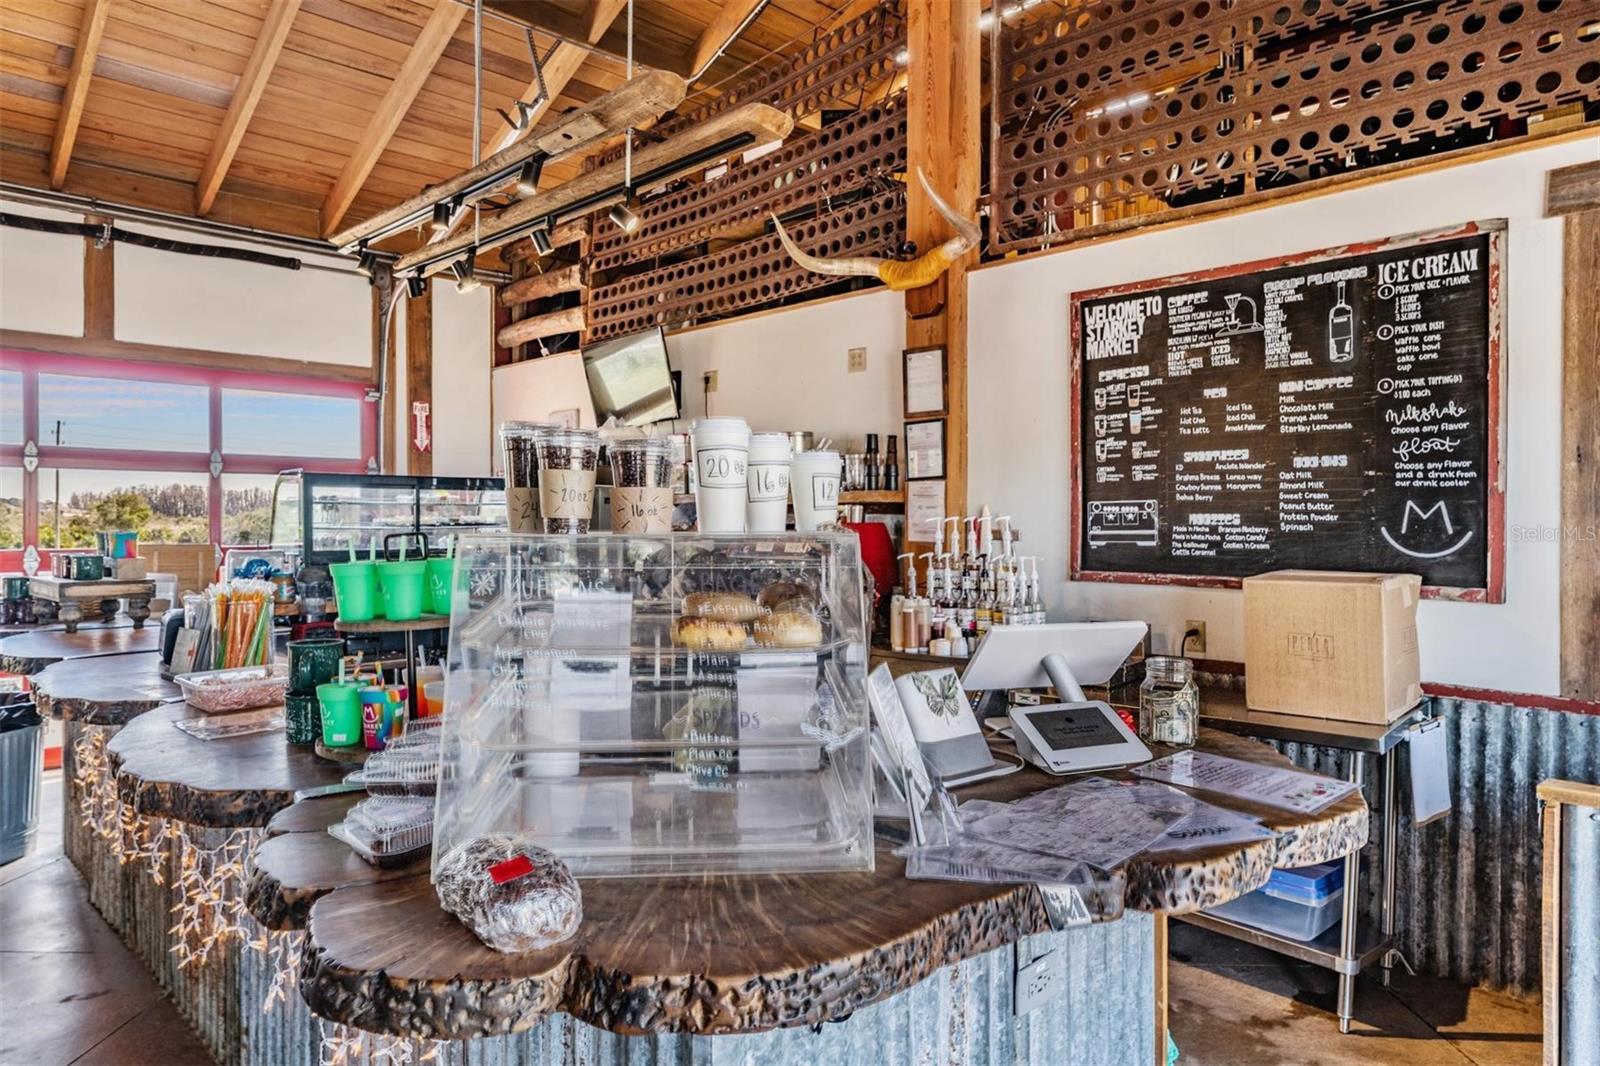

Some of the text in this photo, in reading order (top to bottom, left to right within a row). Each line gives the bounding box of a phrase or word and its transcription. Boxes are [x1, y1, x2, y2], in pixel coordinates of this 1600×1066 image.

[1378, 248, 1479, 285] ICE CREAM
[1395, 284, 1410, 294] PICK
[1411, 281, 1426, 292] YOUR
[1168, 291, 1208, 309] COFFEE
[1400, 302, 1421, 313] SCOOPS
[1400, 311, 1421, 321] SCOOPS
[1086, 316, 1146, 341] STARKEY
[1395, 320, 1445, 335] PICK YOUR DISH
[1395, 334, 1441, 345] waffle cone
[1086, 334, 1140, 360] MARKET
[1211, 345, 1231, 355] ICED
[1395, 342, 1440, 354] waffle bowl
[1168, 351, 1185, 361] HOT
[1397, 352, 1439, 363] cake cone
[1397, 364, 1412, 373] cup
[1394, 380, 1410, 389] PICK
[1411, 378, 1425, 387] YOUR
[1412, 388, 1431, 397] each
[1192, 406, 1203, 414] Tea
[1226, 402, 1253, 412] Iced Tea
[1279, 402, 1335, 413] Chocolate Milk
[1385, 400, 1467, 425] Milkshake
[1240, 413, 1256, 421] Chai
[1280, 413, 1329, 424] Orange Juice
[1179, 427, 1192, 435] Tea
[1280, 422, 1353, 434] Starkey Lemonade
[1422, 424, 1439, 434] any
[1392, 436, 1460, 461] float
[706, 455, 729, 478] 20
[1426, 462, 1444, 470] any
[1279, 471, 1312, 480] Oat Milk
[1428, 470, 1455, 478] drink
[1456, 470, 1477, 478] from
[757, 469, 775, 494] 16
[1308, 481, 1325, 489] Milk
[1412, 479, 1438, 487] drink
[1439, 479, 1470, 487] cooler
[561, 489, 577, 502] 20
[821, 480, 834, 500] 12
[1279, 491, 1329, 500] Sweet Cream
[521, 502, 538, 519] 24
[631, 504, 645, 518] 16
[1279, 502, 1335, 511] Peanut Butter
[1280, 512, 1339, 522] Protein Powder
[1280, 522, 1314, 533] Spinach
[699, 652, 729, 666] Plain
